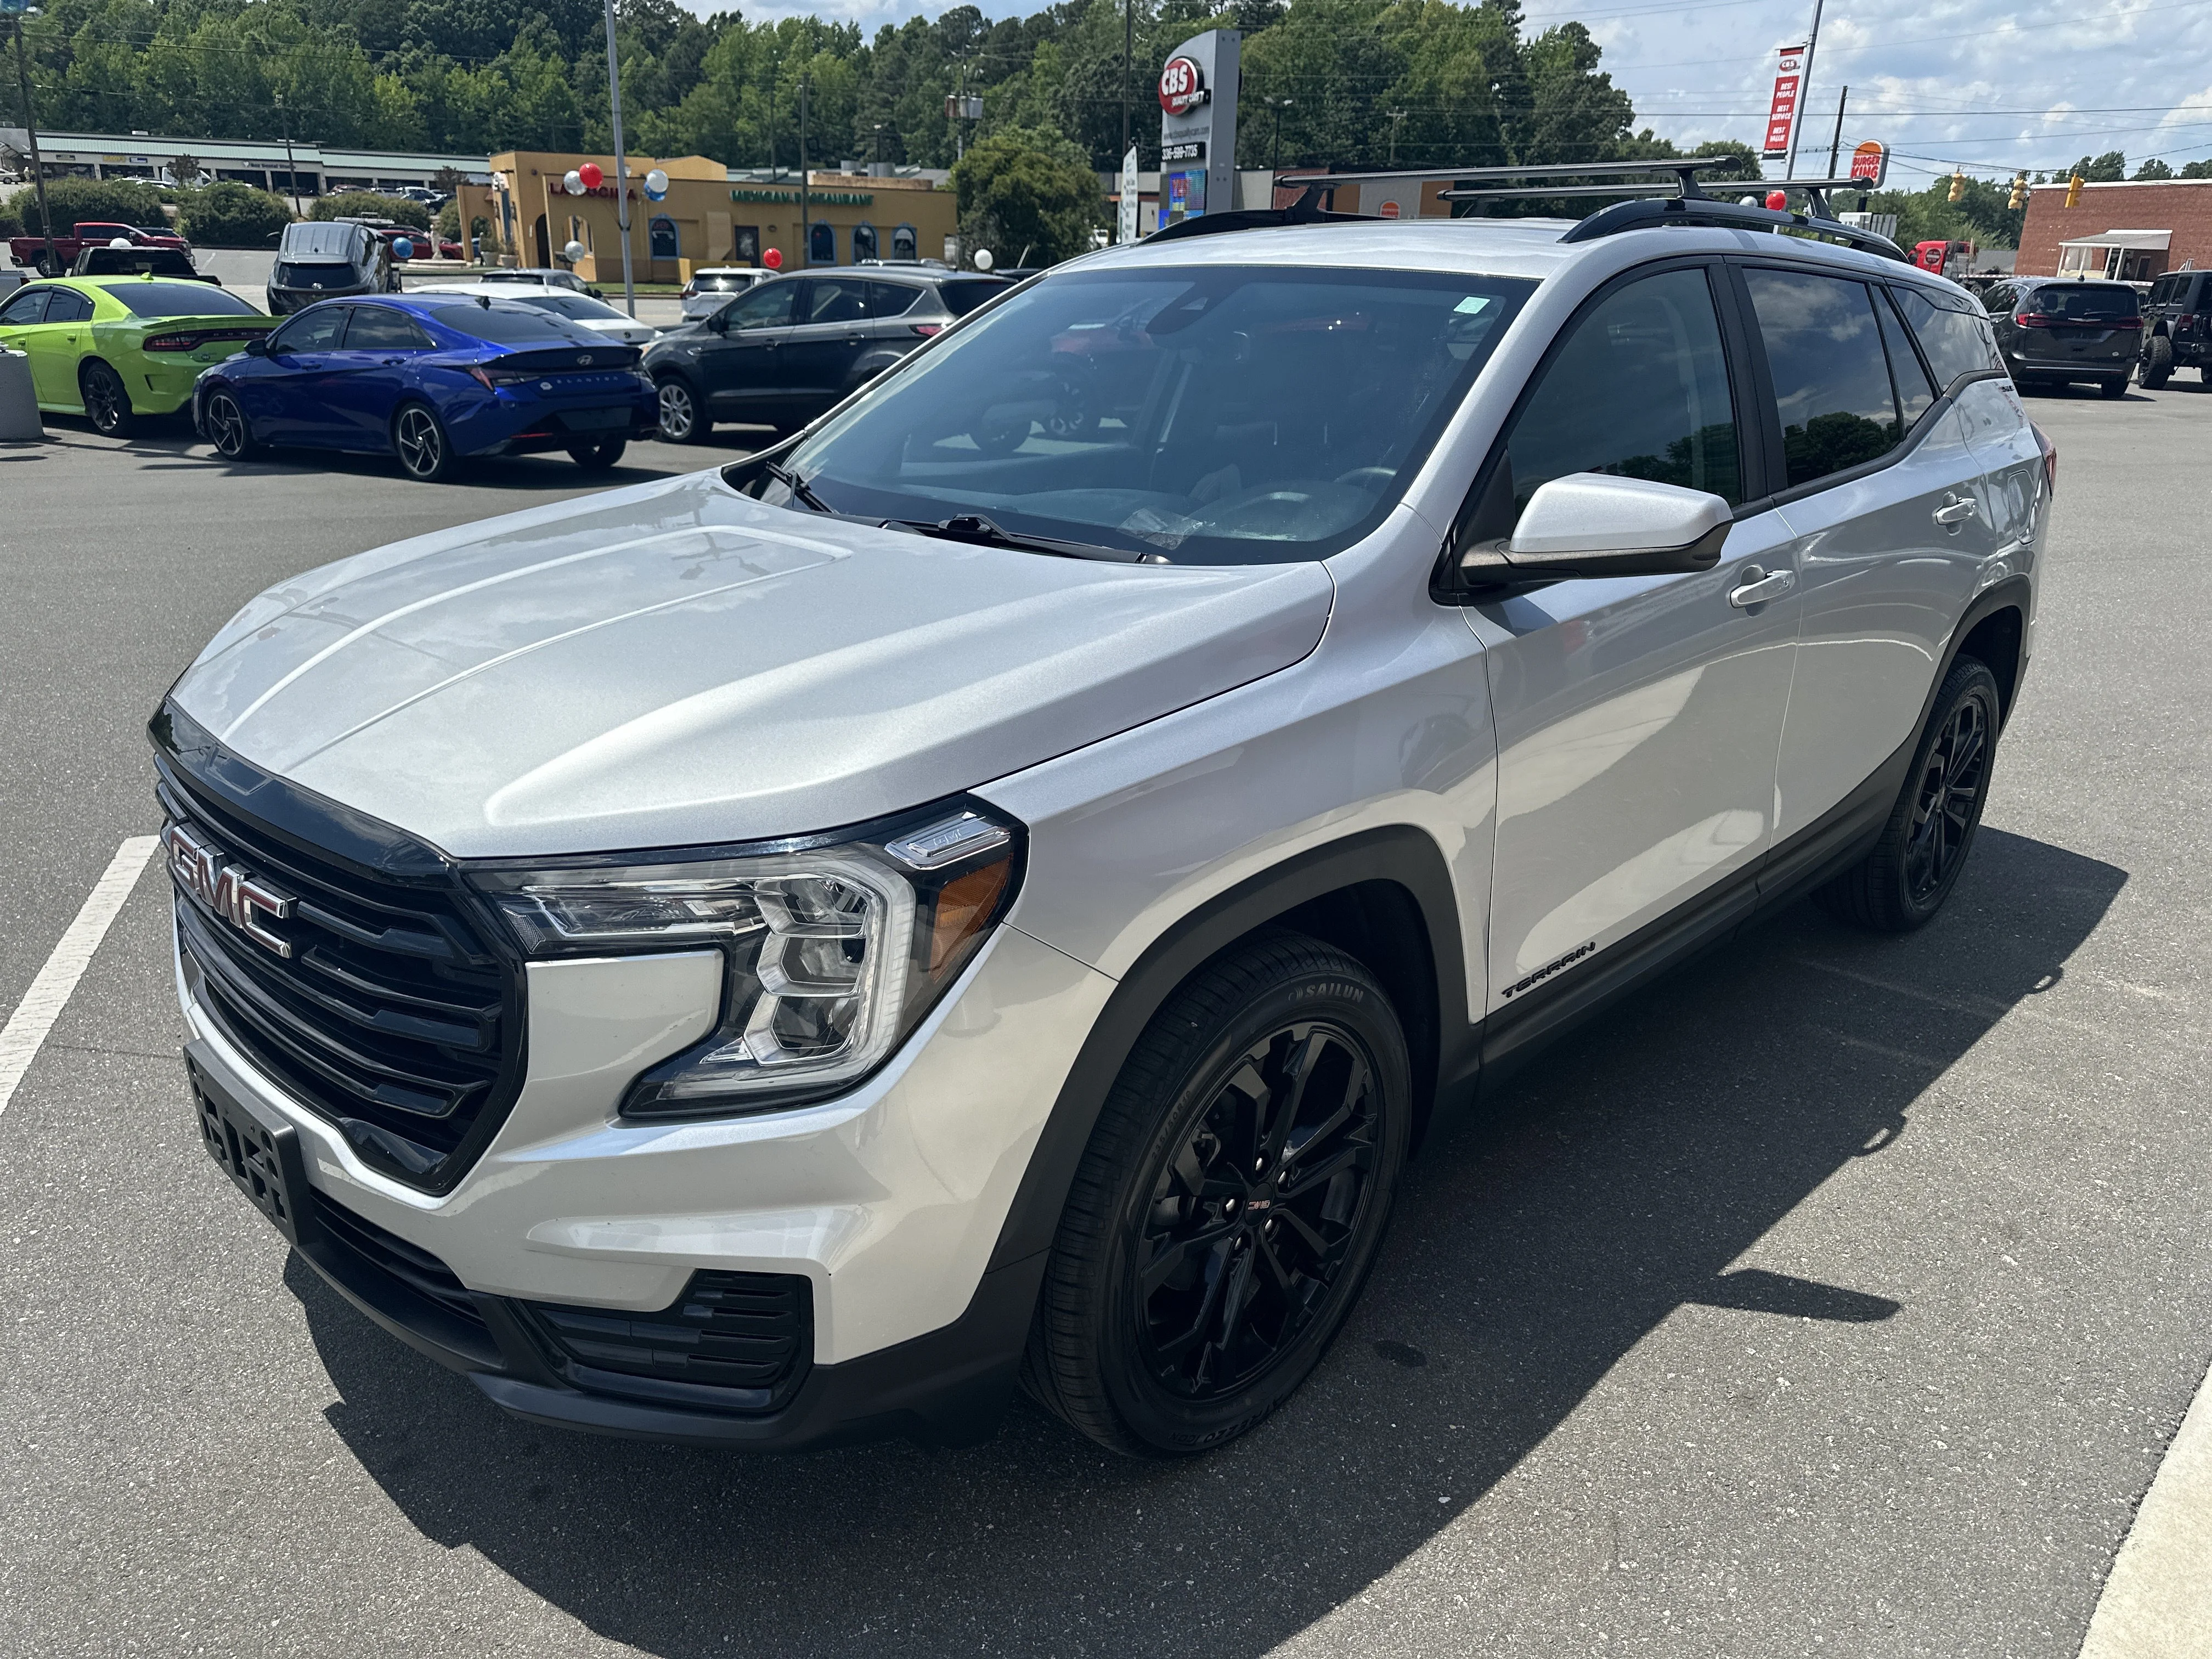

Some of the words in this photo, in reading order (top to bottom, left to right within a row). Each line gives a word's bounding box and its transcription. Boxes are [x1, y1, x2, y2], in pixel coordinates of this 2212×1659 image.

[1161, 64, 1188, 96] CBS
[1780, 82, 1794, 90] BEST
[1776, 90, 1795, 99] PEOPLE
[1776, 104, 1790, 112] BEST
[1771, 112, 1792, 121] SERVICE
[1773, 126, 1786, 134] BEST
[1769, 134, 1786, 143] VALUE
[1853, 155, 1881, 166] BURGER
[1851, 166, 1879, 179] KING
[171, 824, 294, 959] GMC
[1501, 941, 1596, 998] TERRAIN
[1305, 983, 1364, 1003] SAILUN
[1248, 1200, 1271, 1210] GMC
